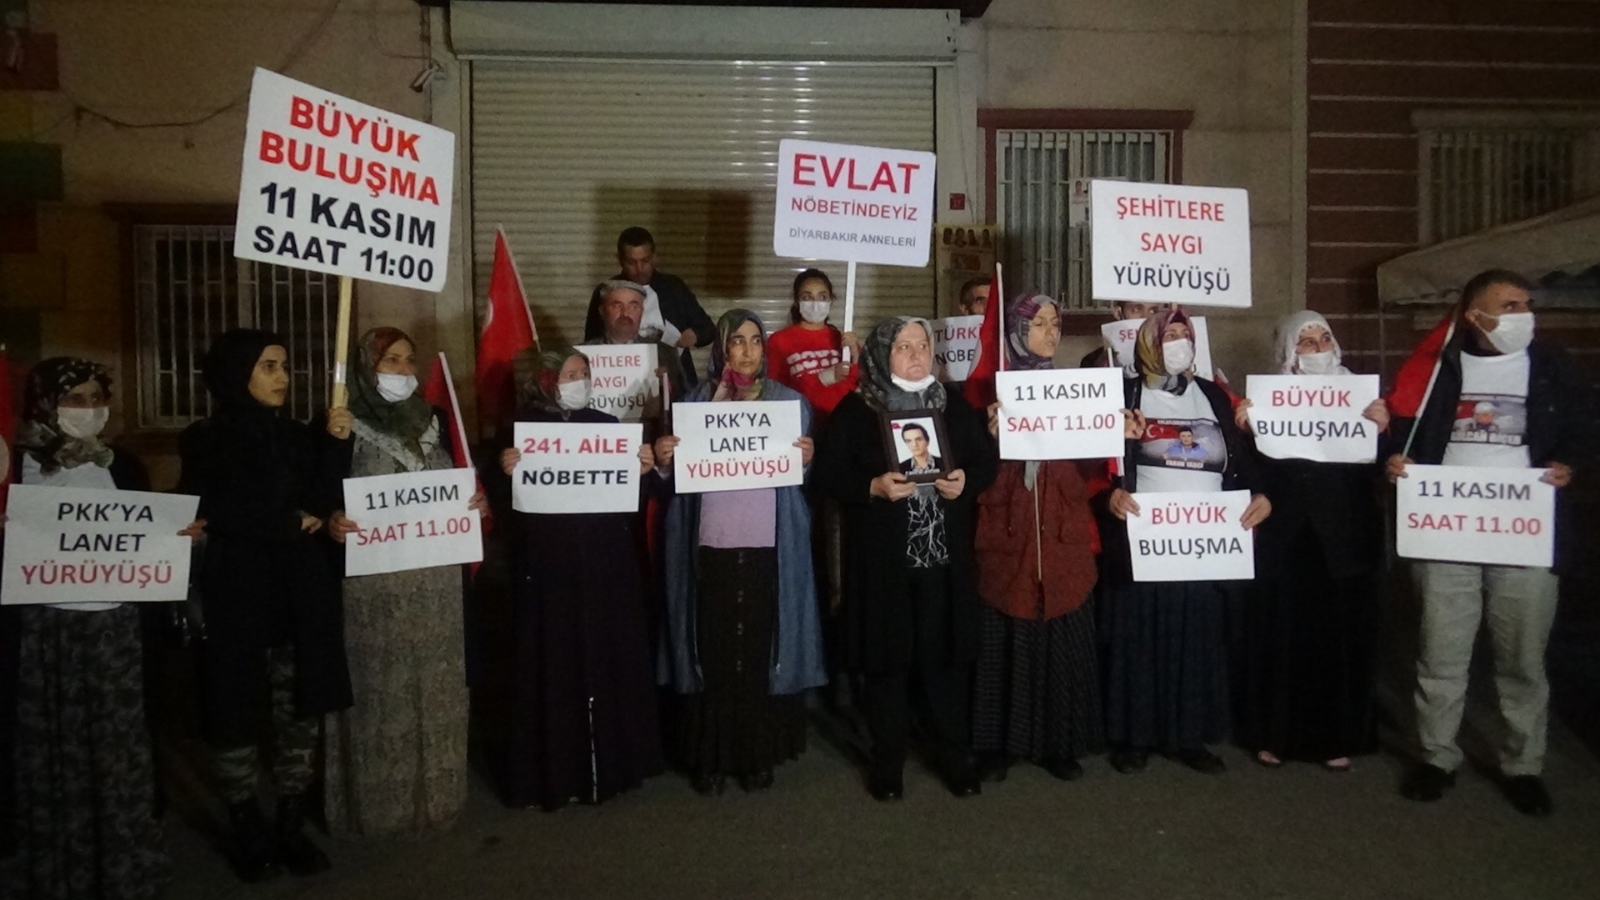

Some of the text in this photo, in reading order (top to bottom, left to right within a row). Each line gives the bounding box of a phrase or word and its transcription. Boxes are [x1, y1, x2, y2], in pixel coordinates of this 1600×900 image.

[290, 95, 421, 163] BÜYÜK
[259, 130, 440, 206] BULUŞMA
[793, 153, 920, 194] EVLAT
[260, 182, 436, 249] 11 KASIM
[791, 196, 918, 221] NÖBETİNDEYİZ
[1116, 194, 1225, 222] ŞEHİTLERE
[789, 226, 916, 247] DİYARBAKIR ANNELERİ
[1141, 232, 1203, 255] SAYGI
[253, 225, 434, 283] SAAT 11:00
[1113, 261, 1231, 295] YÜRÜYÜŞÜ
[1015, 383, 1107, 401] 11 KASIM
[1272, 386, 1351, 408] BÜYÜK
[704, 412, 771, 429] PKK'YA
[1007, 413, 1116, 433] SAAT 11.00
[1256, 420, 1367, 441] BULUŞMA
[523, 435, 629, 454] 241. AİLE
[709, 435, 769, 453] LANET
[522, 467, 629, 486] NÖBETTE
[686, 455, 790, 479] YÜRÜYÜŞÜ
[365, 484, 460, 511] 11 KASIM
[1418, 480, 1531, 501] 11 KASIM
[57, 502, 154, 523] PKK'YA
[1151, 502, 1227, 525] BÜYÜK
[1407, 512, 1542, 536] SAAT 11.00
[58, 532, 146, 552] LANET
[357, 516, 471, 546] SAAT 11.00
[1139, 537, 1244, 560] BULUŞMA
[20, 559, 173, 589] YÜRÜYÜŞÜ
